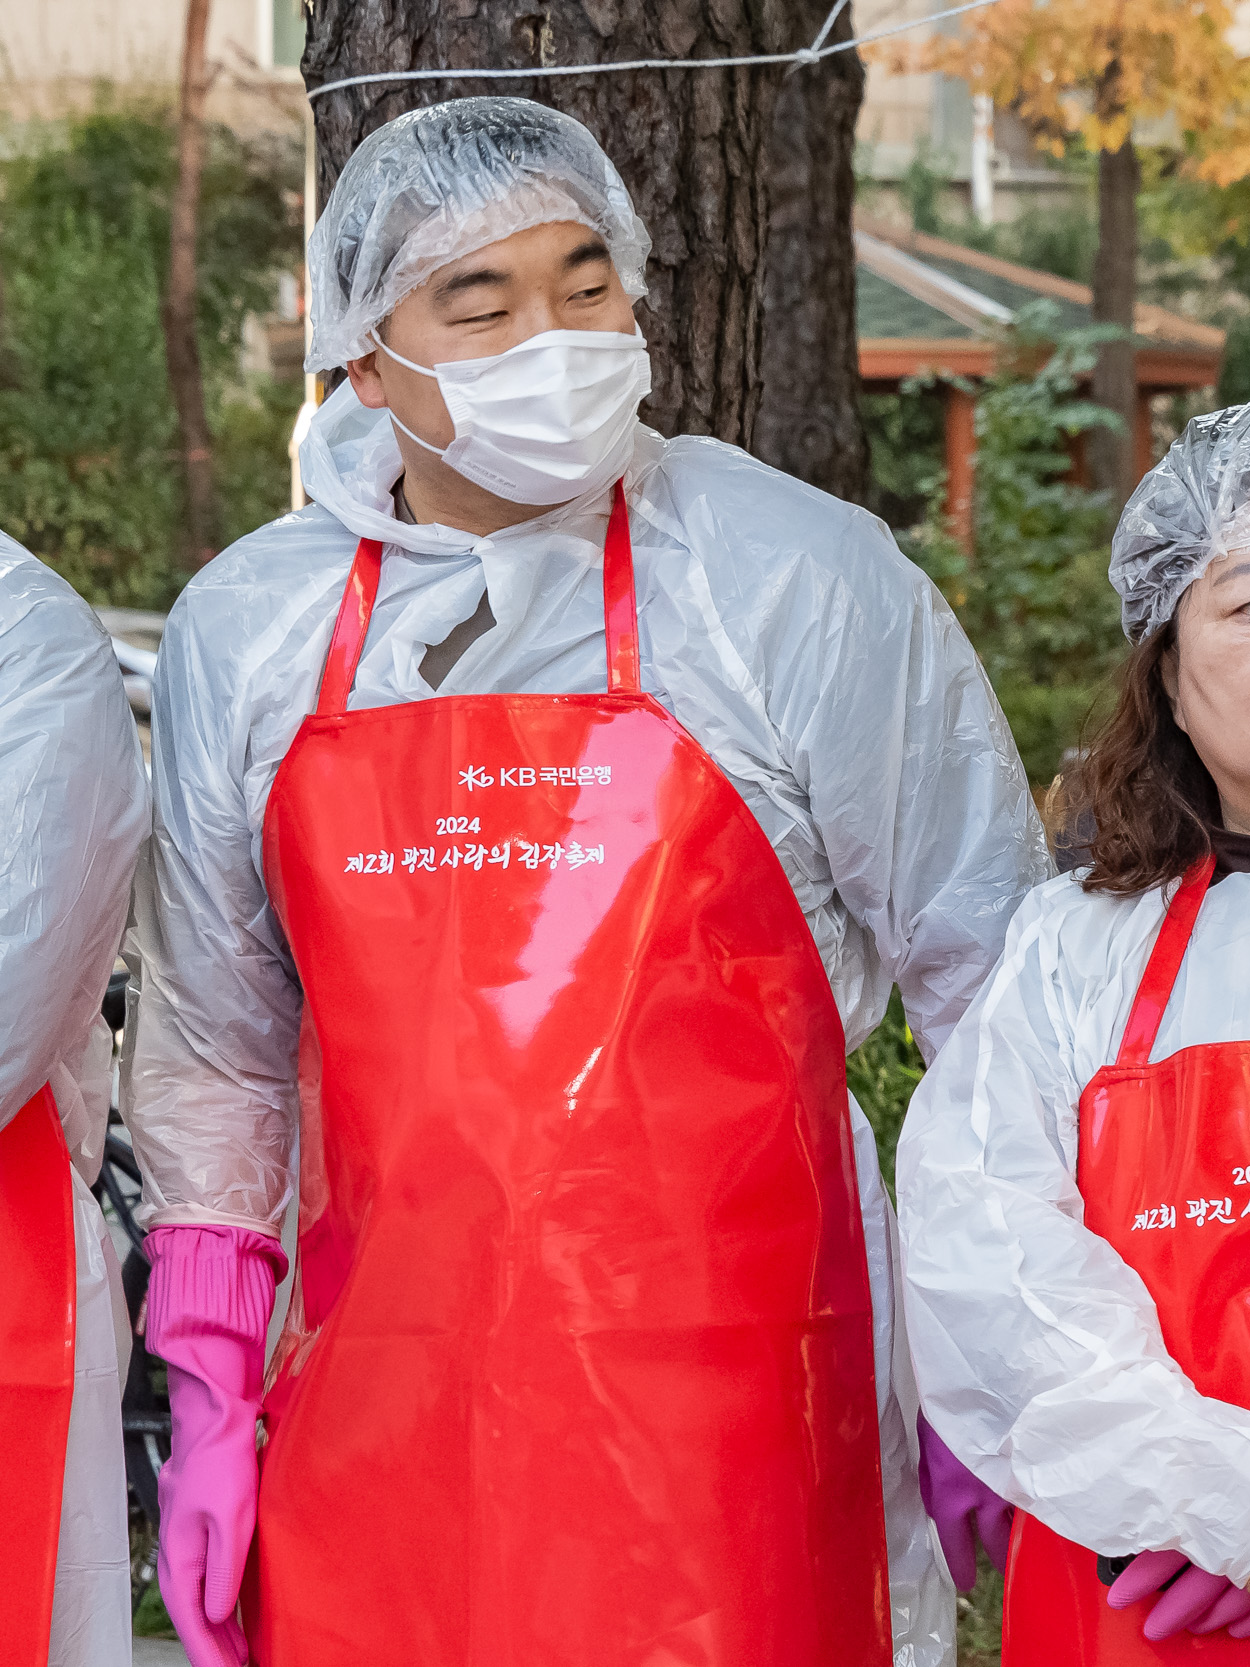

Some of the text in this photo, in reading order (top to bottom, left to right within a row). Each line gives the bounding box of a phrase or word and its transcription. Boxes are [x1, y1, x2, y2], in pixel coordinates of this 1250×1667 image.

[436, 816, 481, 835] 2024
[344, 849, 394, 874] 제2회
[401, 846, 437, 873] 광진
[440, 842, 512, 870] 사랑의
[1131, 1204, 1176, 1231] 제2회
[1185, 1197, 1236, 1227] 광진
